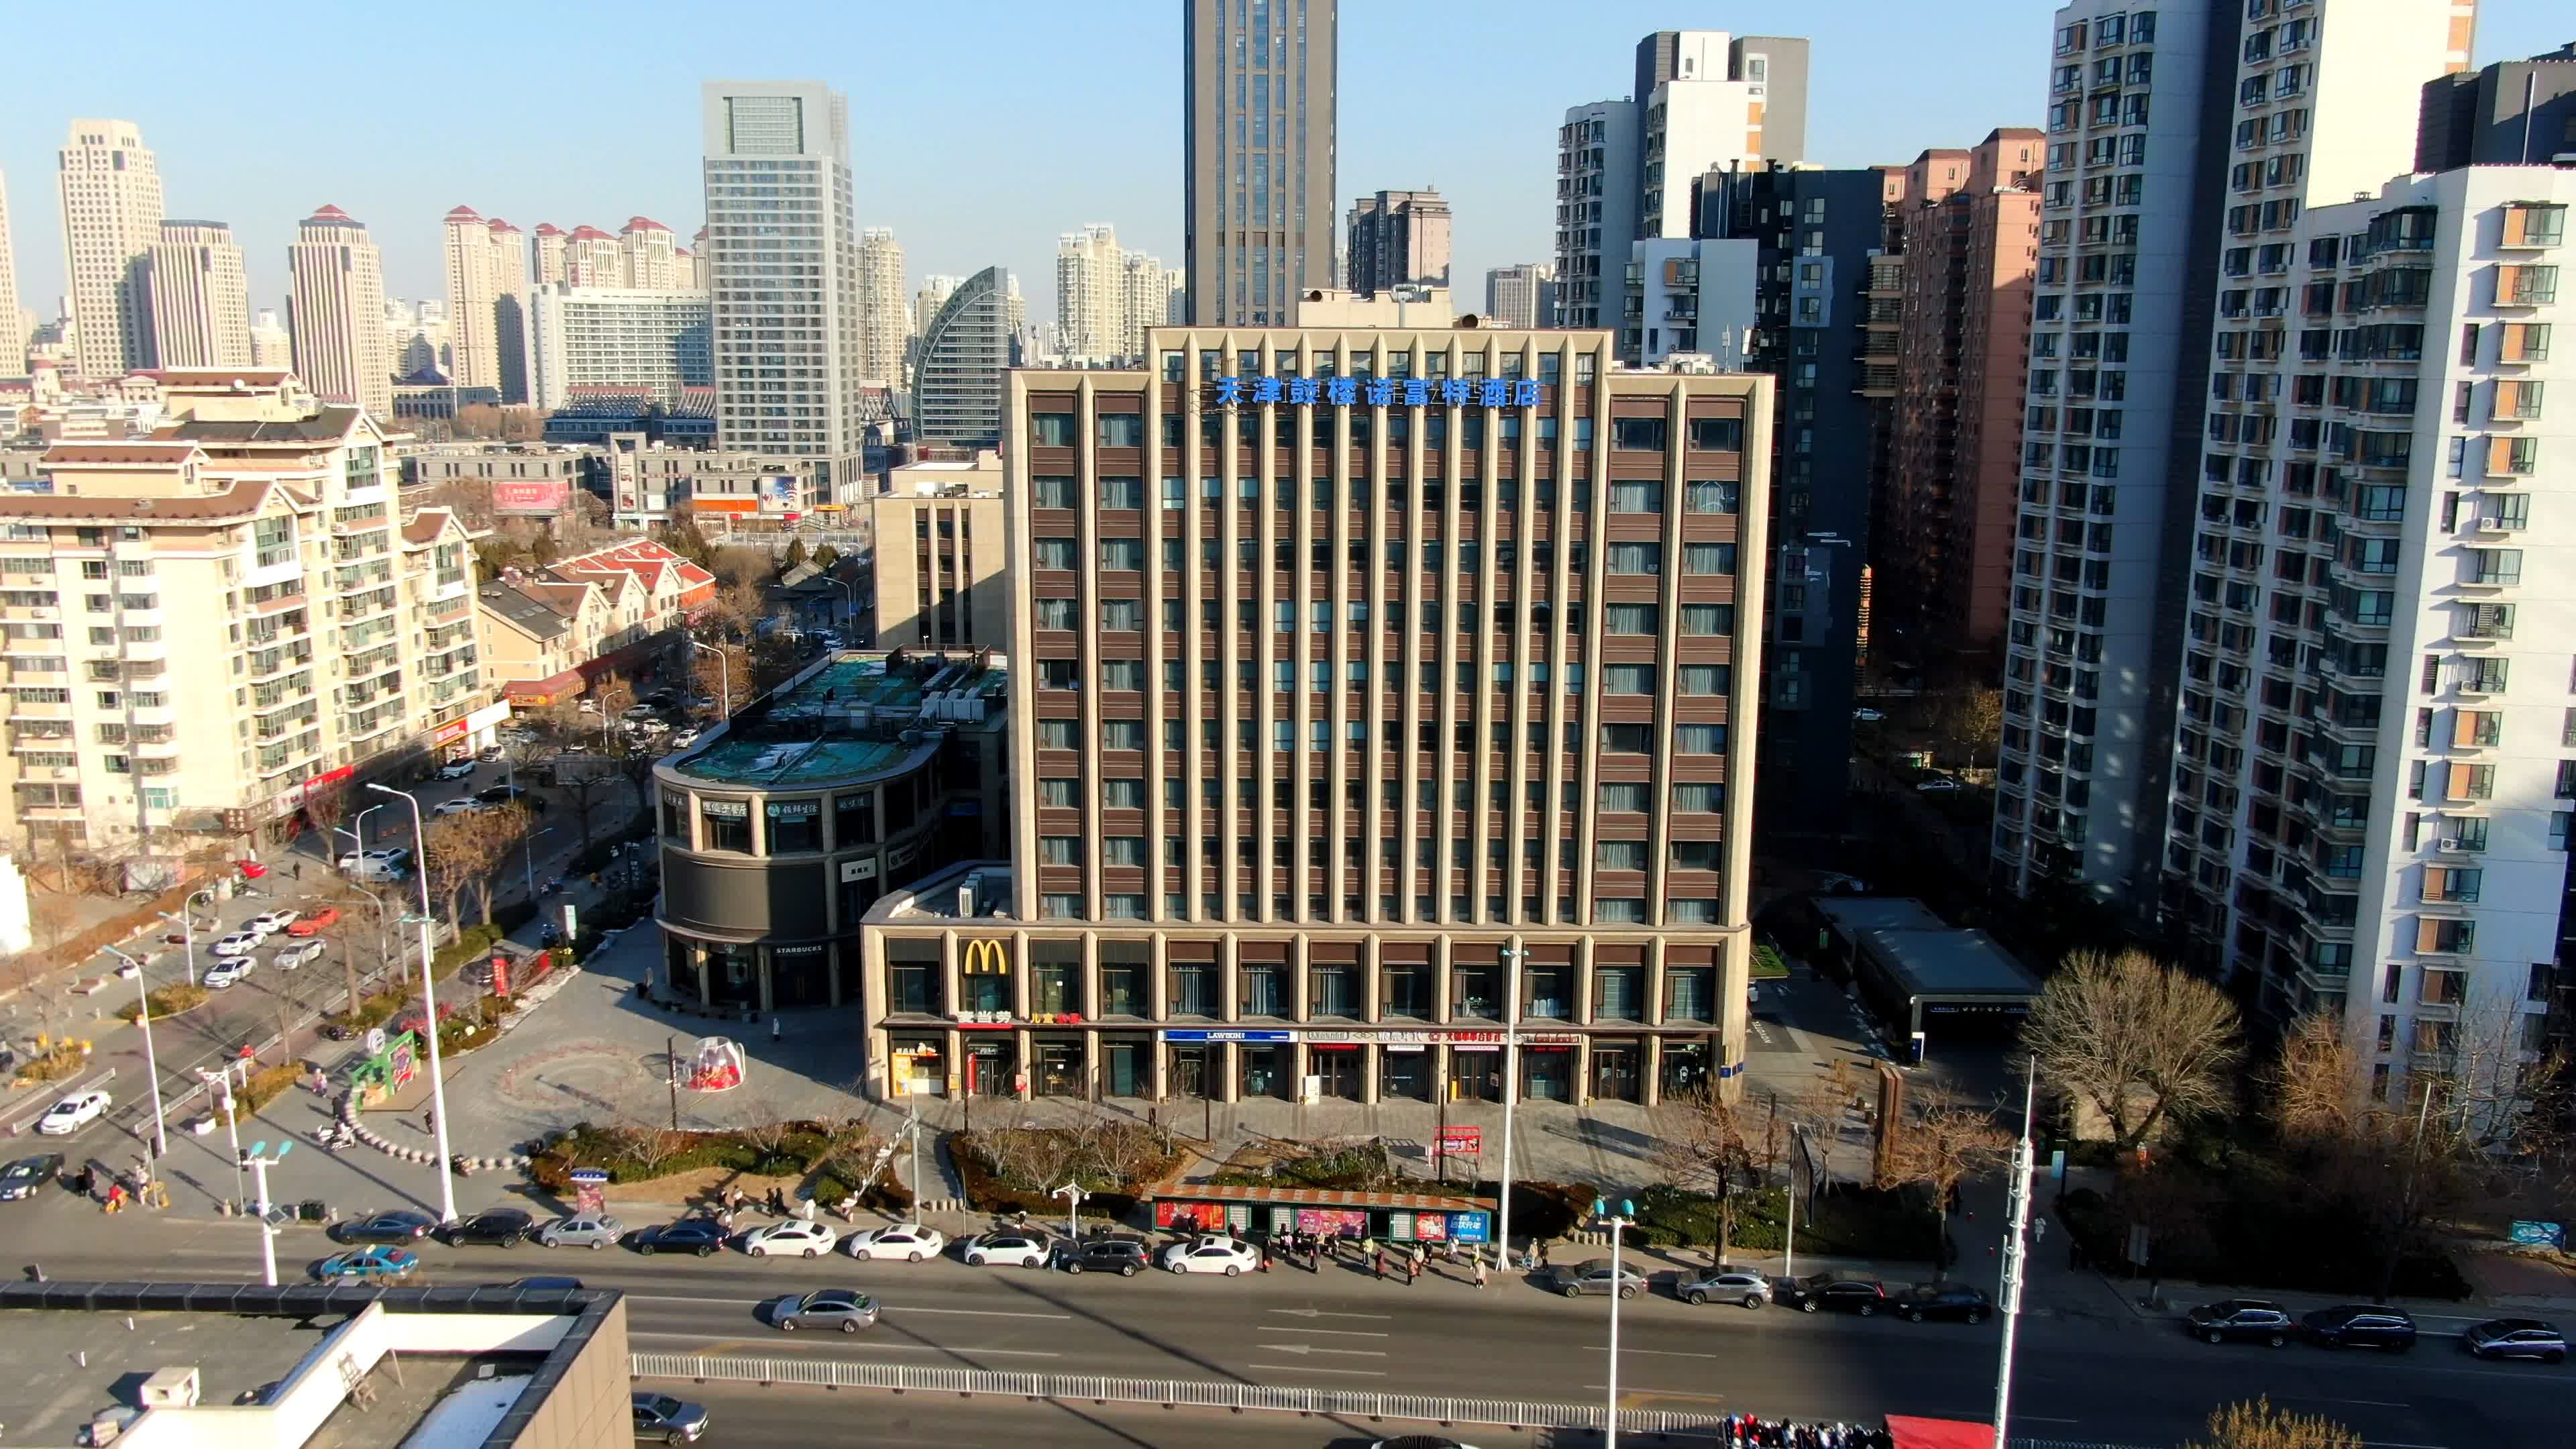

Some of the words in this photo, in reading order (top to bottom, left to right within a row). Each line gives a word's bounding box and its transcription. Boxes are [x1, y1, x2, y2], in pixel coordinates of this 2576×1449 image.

[1216, 376, 1542, 407] 天津鼓楼诺富特酒店
[776, 945, 822, 953] STARBUCKS
[957, 1010, 1012, 1024] 麦当劳
